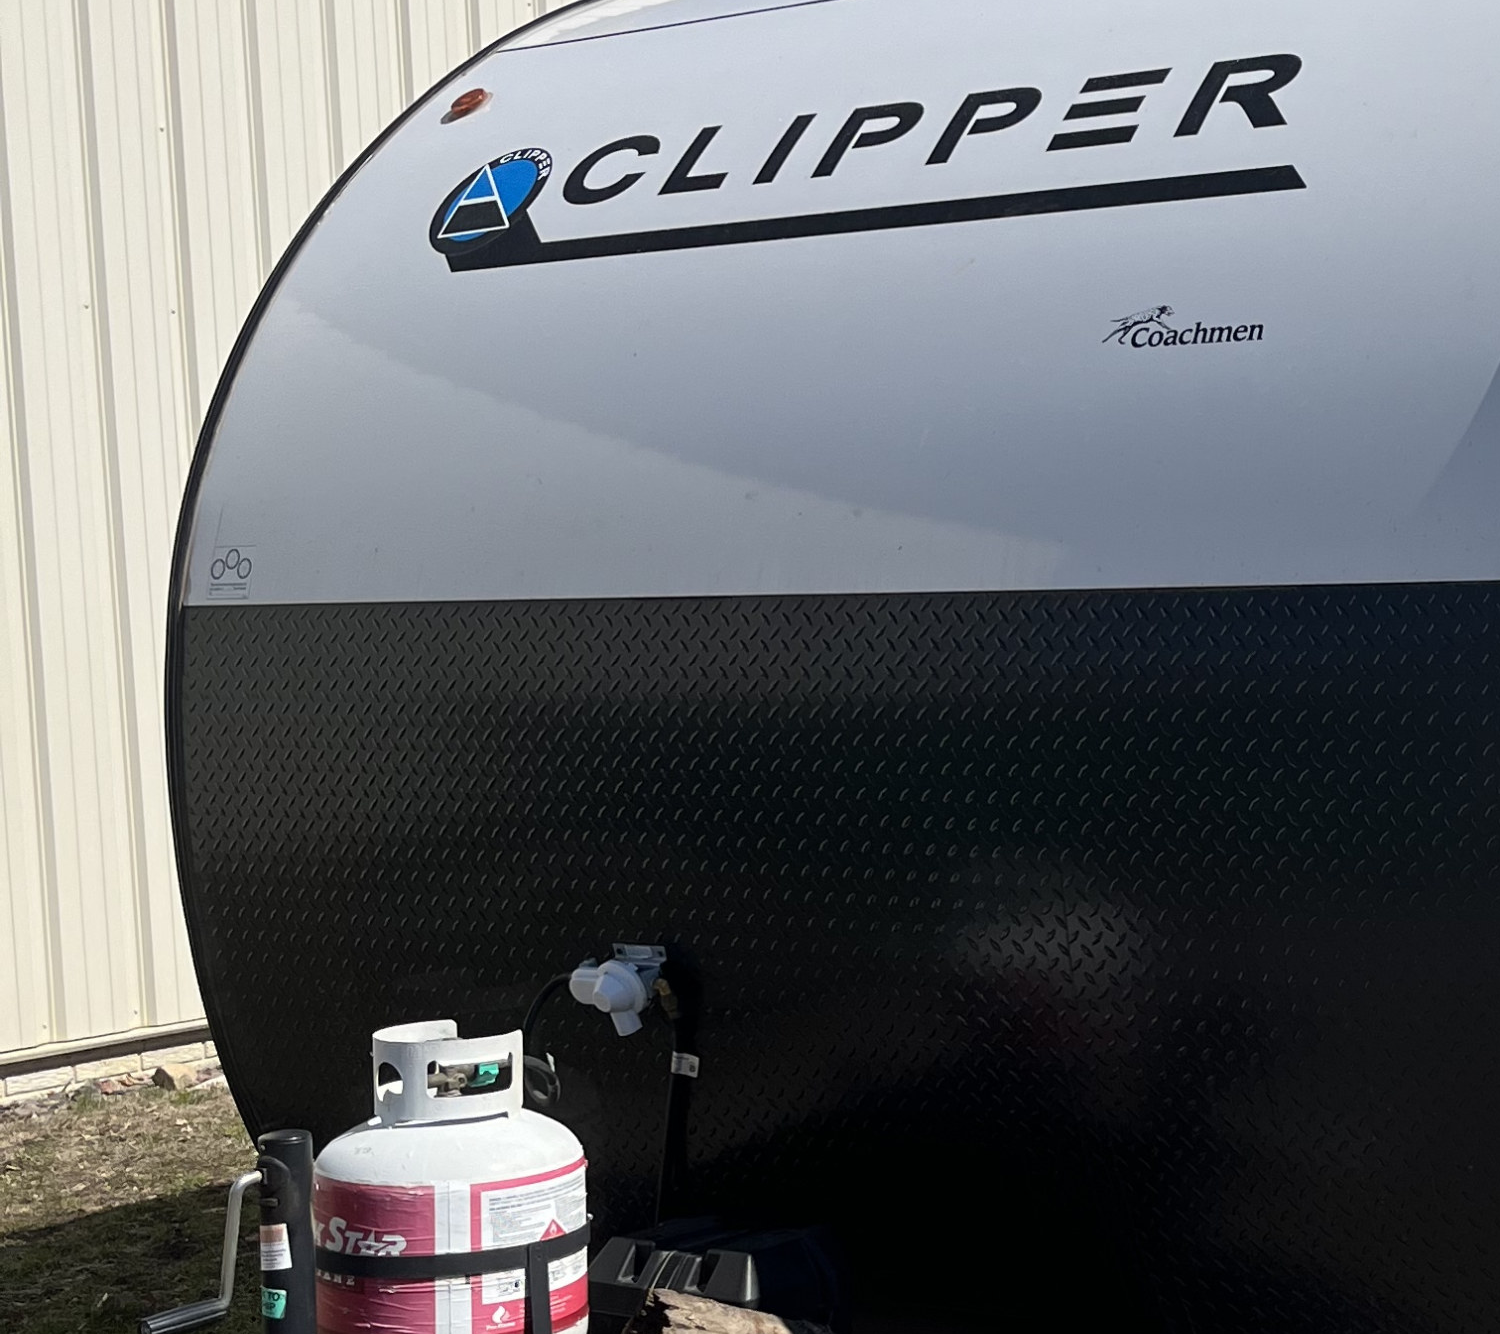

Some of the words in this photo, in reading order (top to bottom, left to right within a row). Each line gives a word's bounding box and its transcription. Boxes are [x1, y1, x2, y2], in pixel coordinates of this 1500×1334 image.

[561, 53, 1304, 205] CLIPPER
[499, 149, 551, 180] CLIPPER
[1130, 321, 1264, 349] Coachmen
